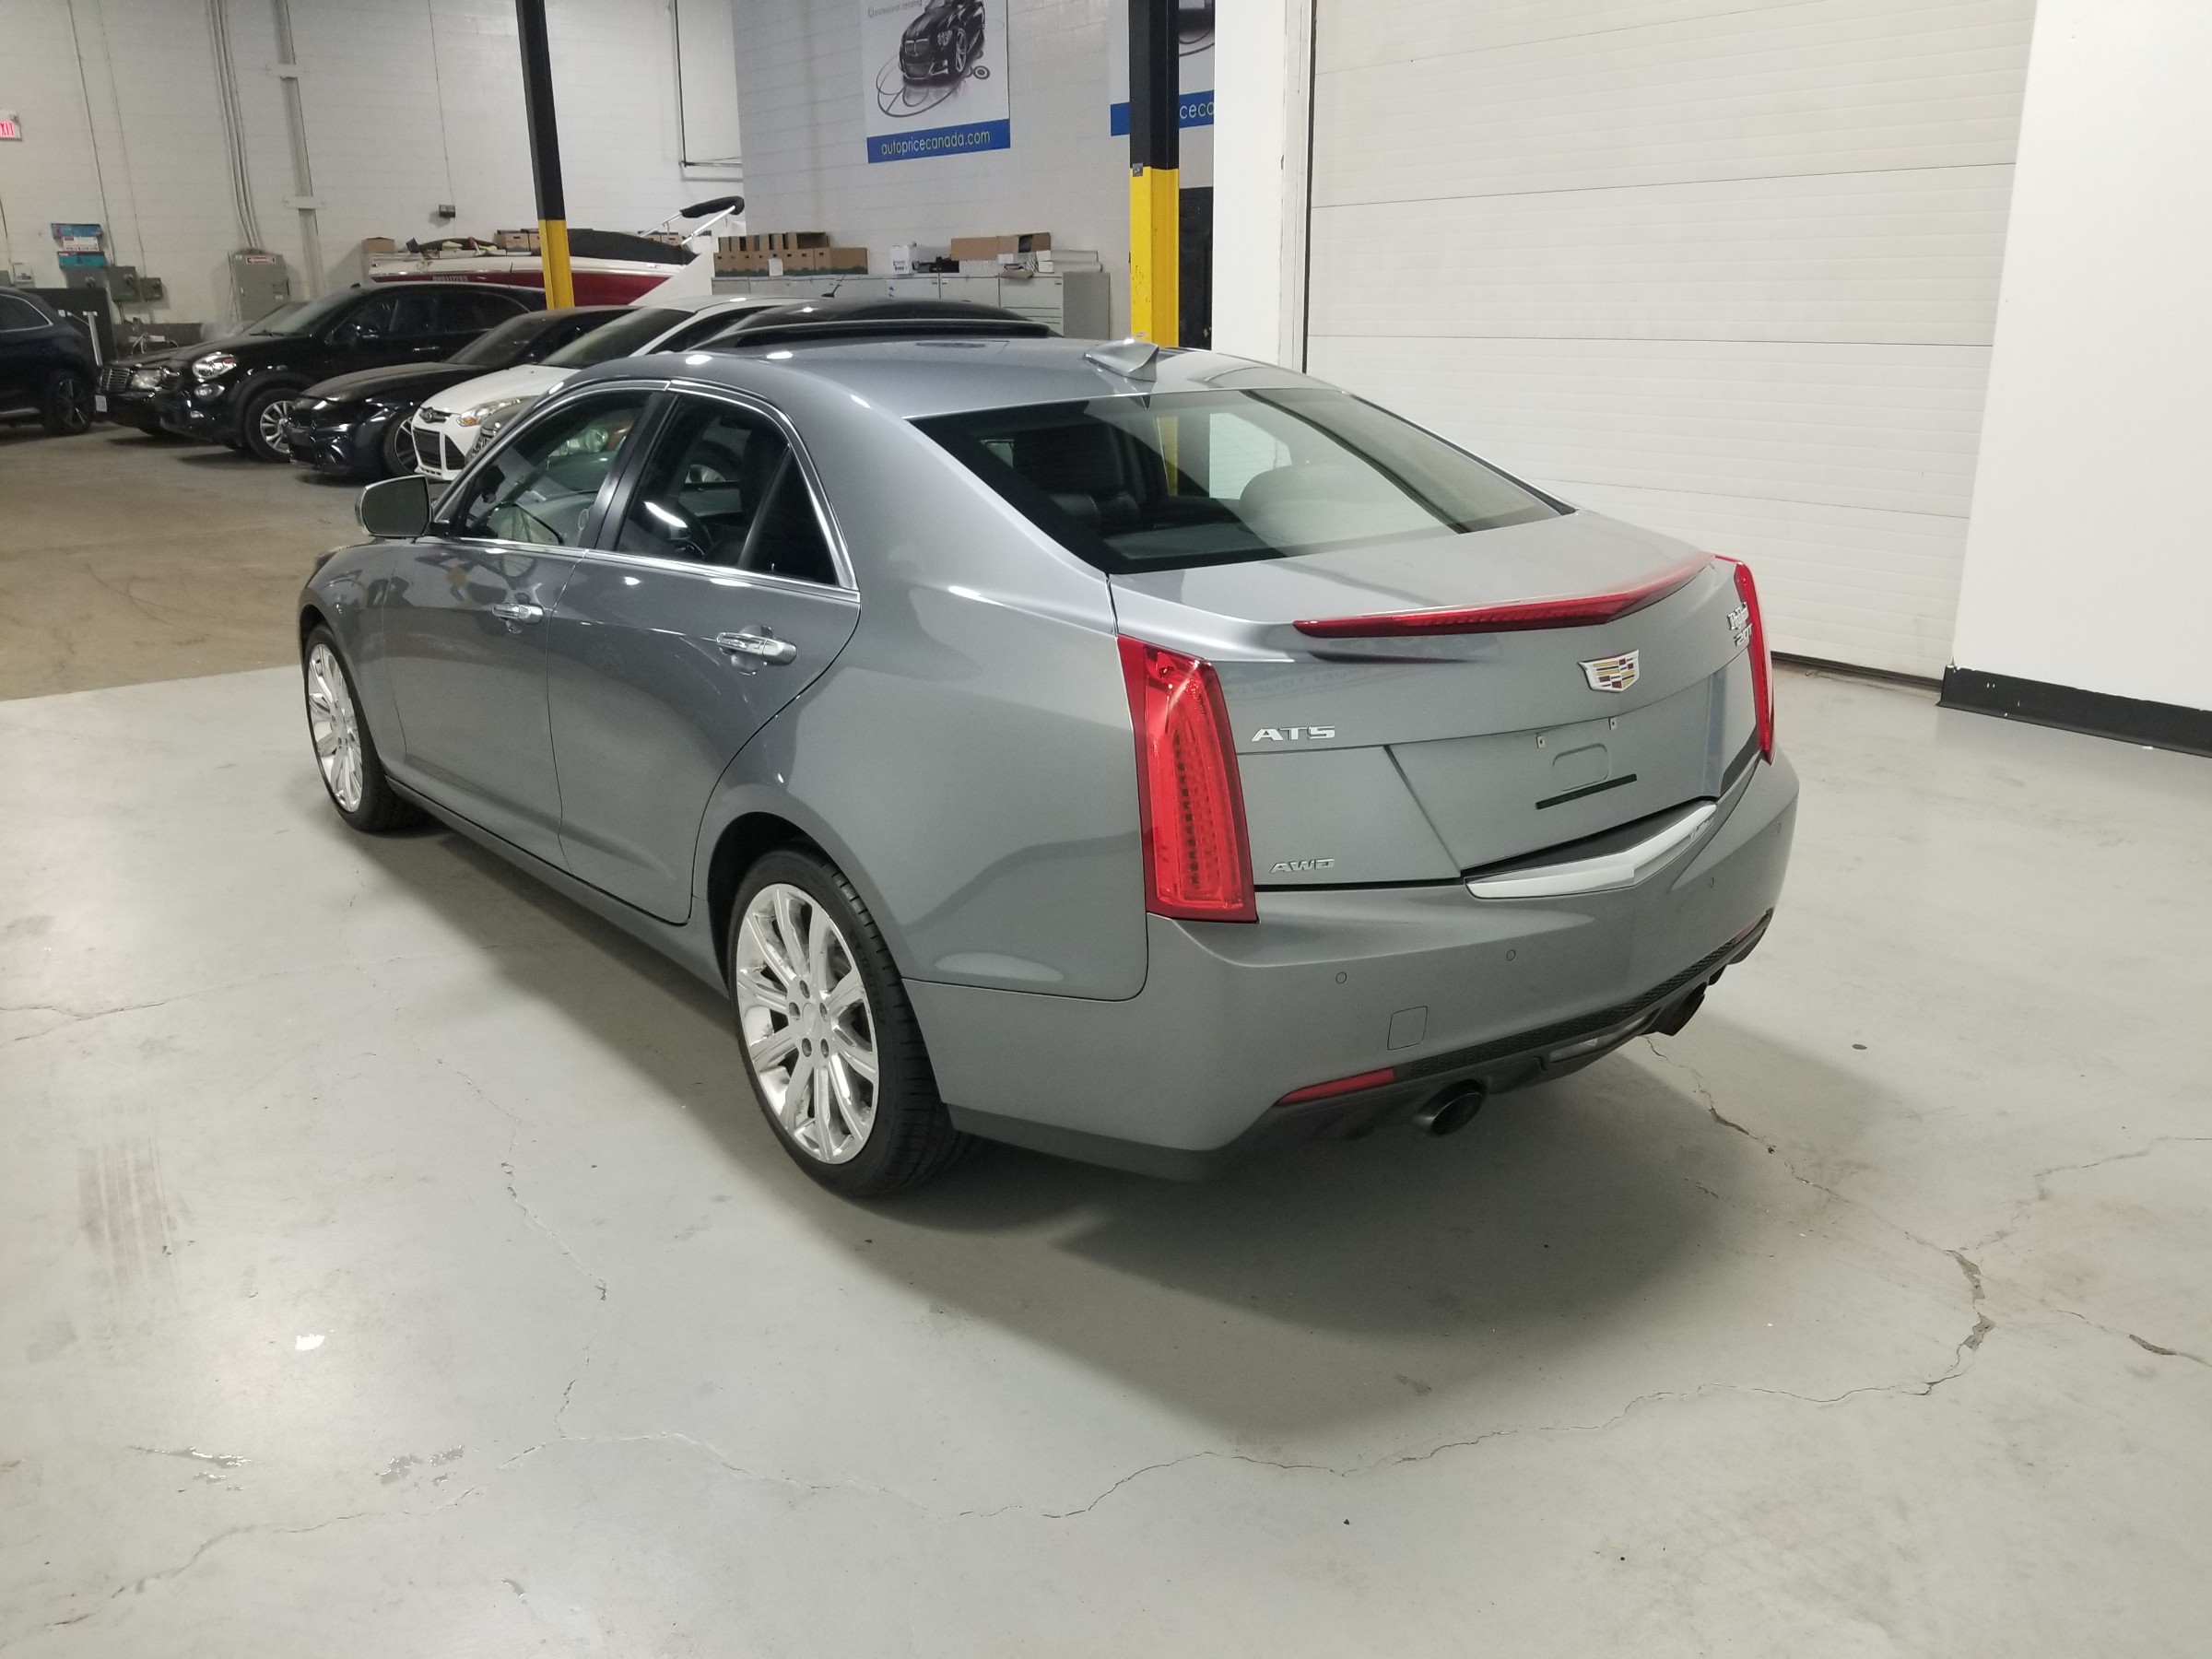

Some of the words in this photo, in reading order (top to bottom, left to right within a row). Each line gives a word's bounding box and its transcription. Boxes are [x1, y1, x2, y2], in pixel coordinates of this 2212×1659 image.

[0, 123, 14, 136] XIT
[881, 130, 991, 156] autopricecanada.com
[1251, 725, 1335, 742] ATS
[1269, 858, 1335, 873] AWD
